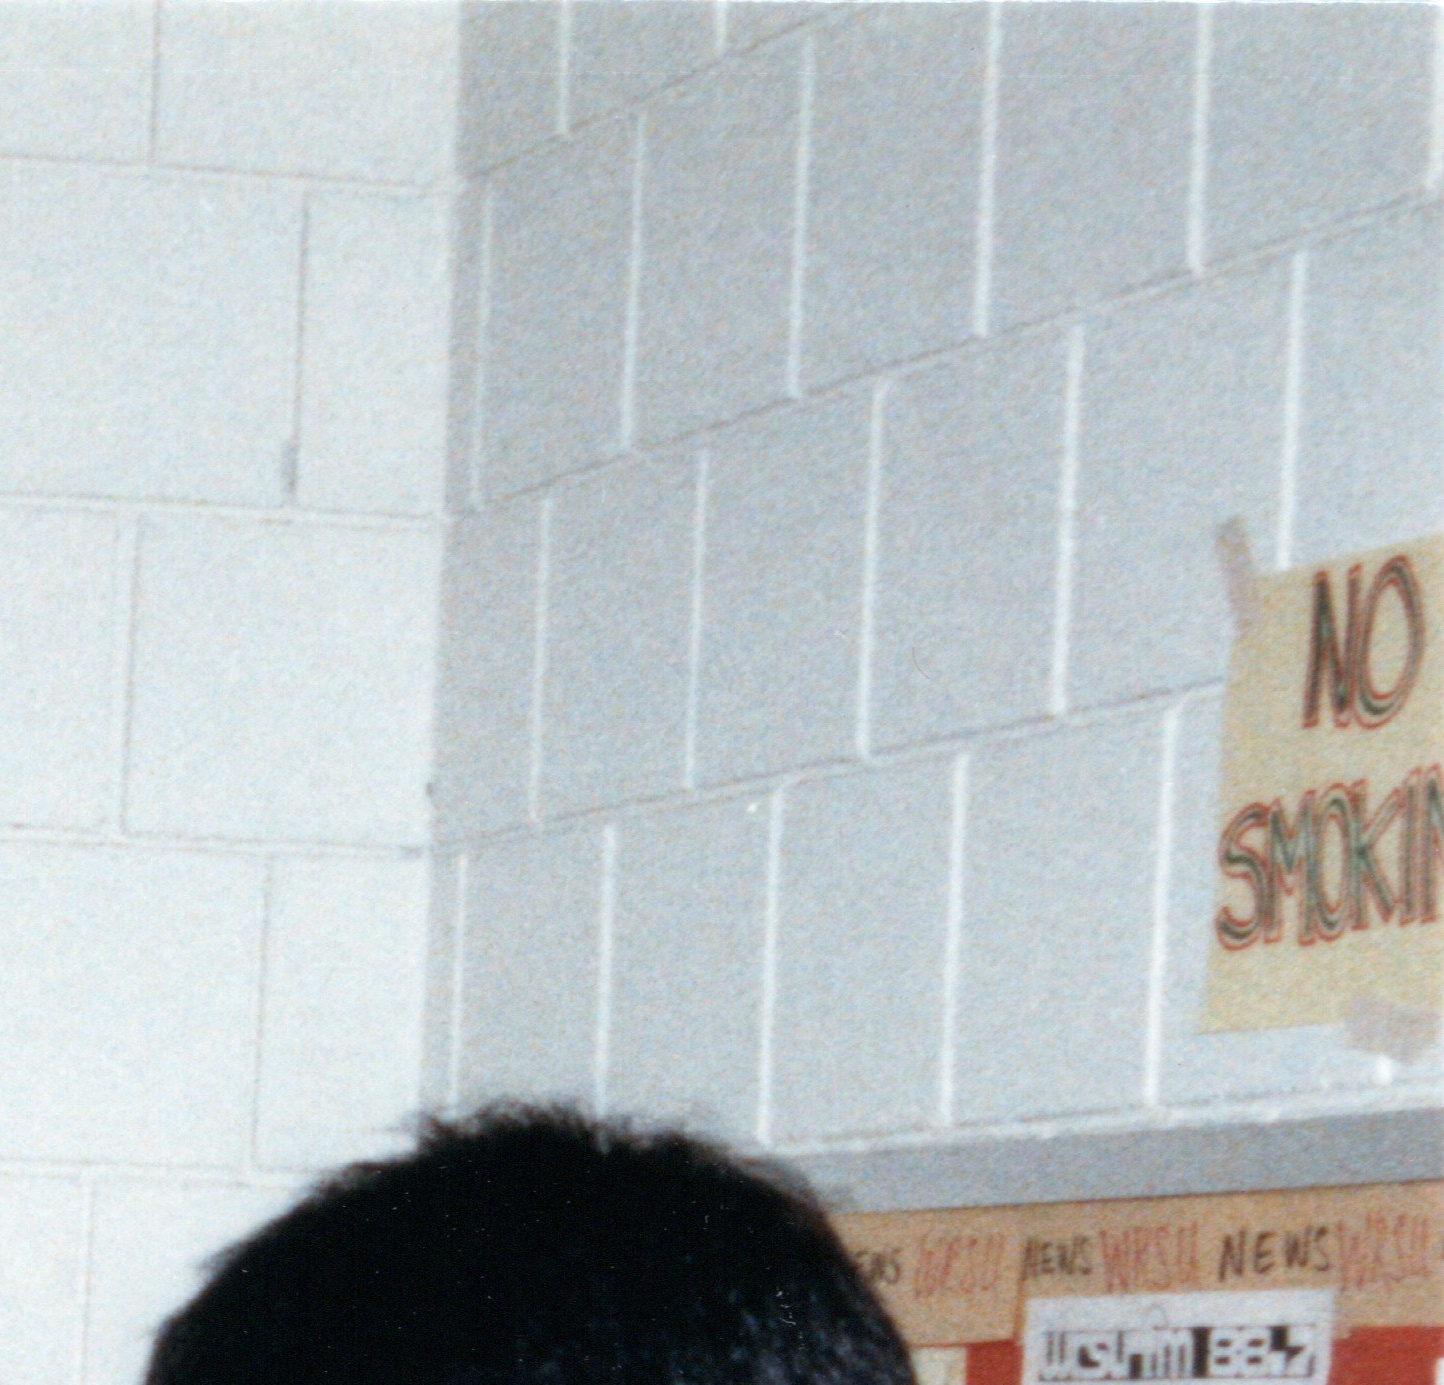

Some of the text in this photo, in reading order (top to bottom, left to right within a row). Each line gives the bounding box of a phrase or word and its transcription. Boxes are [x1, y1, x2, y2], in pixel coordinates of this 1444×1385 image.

[1302, 555, 1425, 729] NO
[1214, 764, 1444, 951] SMOKIN
[1023, 1234, 1093, 1281] NEWS
[1218, 1225, 1330, 1282] NEWS
